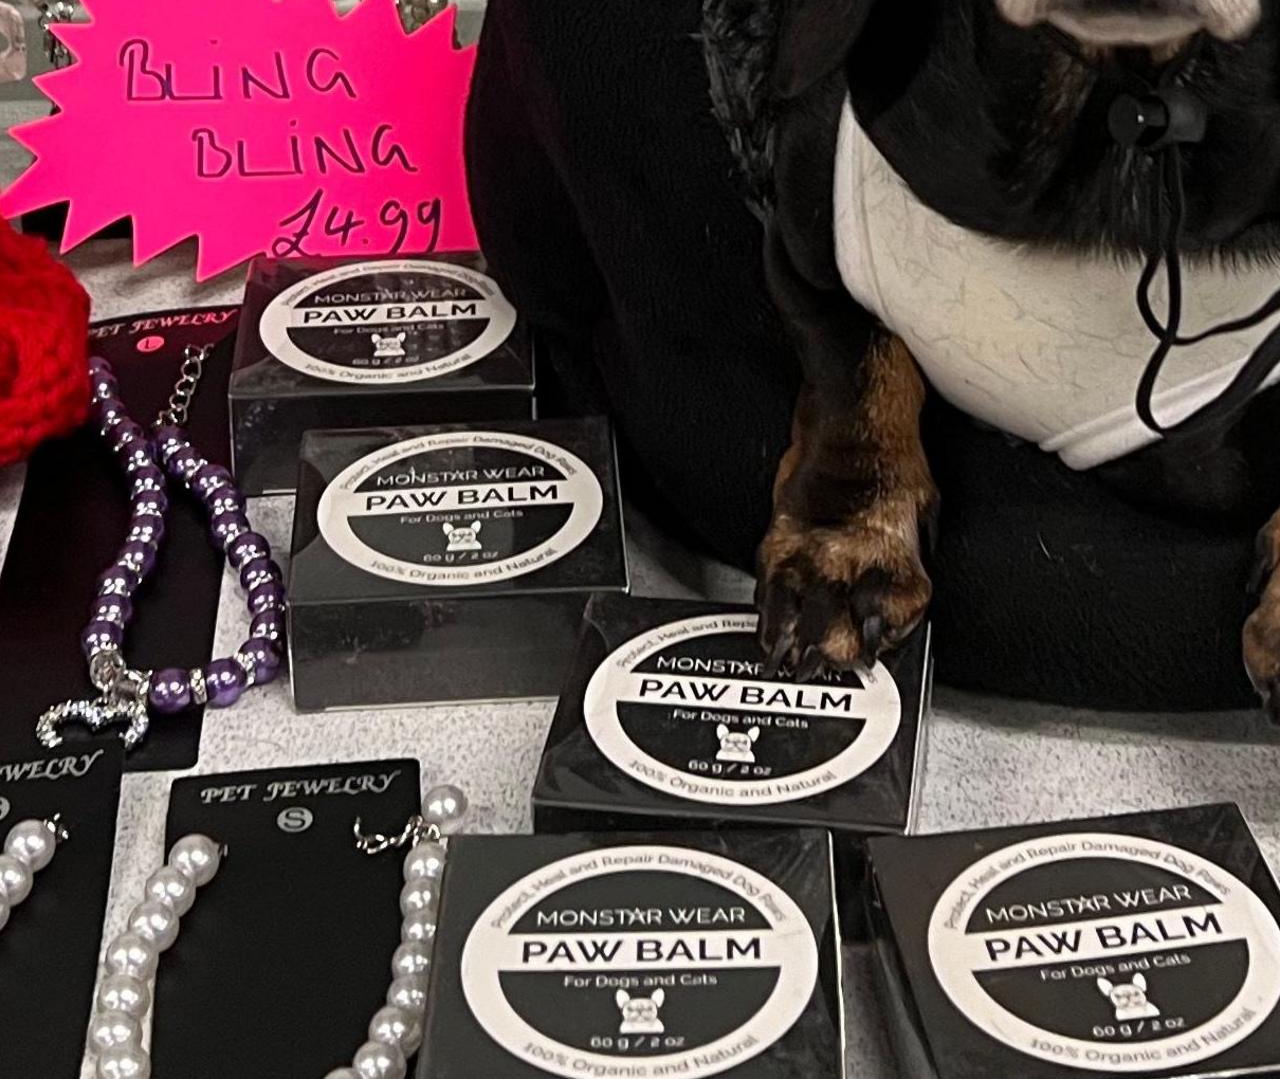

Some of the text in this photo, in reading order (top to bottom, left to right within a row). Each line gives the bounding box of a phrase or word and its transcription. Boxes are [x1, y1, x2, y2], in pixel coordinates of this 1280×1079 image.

[271, 189, 442, 258] £4.99
[129, 309, 238, 334] JEWELRY
[303, 304, 477, 324] PAW BALM
[377, 469, 478, 487] MONSTAR
[485, 466, 545, 480] WEAR
[365, 485, 558, 511] PAW BALM
[401, 516, 421, 525] For
[722, 619, 757, 629] Repa
[639, 679, 852, 712] PAW BALM
[672, 708, 808, 729] For Dogs and Cats
[200, 770, 402, 804] PET JEWELRY
[670, 777, 735, 798] Organic
[739, 783, 772, 798] and
[775, 771, 837, 794] Natural
[283, 810, 307, 829] S
[998, 851, 1027, 871] and
[1027, 841, 1077, 859] Repair
[1080, 840, 1162, 863] Damaged
[1163, 852, 1196, 879] Dog
[569, 859, 598, 877] and
[601, 854, 654, 868] Repair
[658, 854, 732, 882] Damaged
[732, 872, 763, 897] Dog
[537, 907, 745, 927] MONSTAR WEAR
[986, 884, 1192, 924] MONSTAR WEAR
[984, 912, 1223, 962] PAW BALM
[522, 938, 761, 964] PAW BALM
[1039, 953, 1191, 981] For Dogs and Cats
[564, 974, 718, 990] For Dogs and Cats
[1030, 1007, 1256, 1065] 100% Organic and Natural
[1092, 1017, 1187, 1039] 60 g / 2 oz
[524, 1035, 759, 1077] 100% Organic and Natural
[617, 1038, 630, 1050] g
